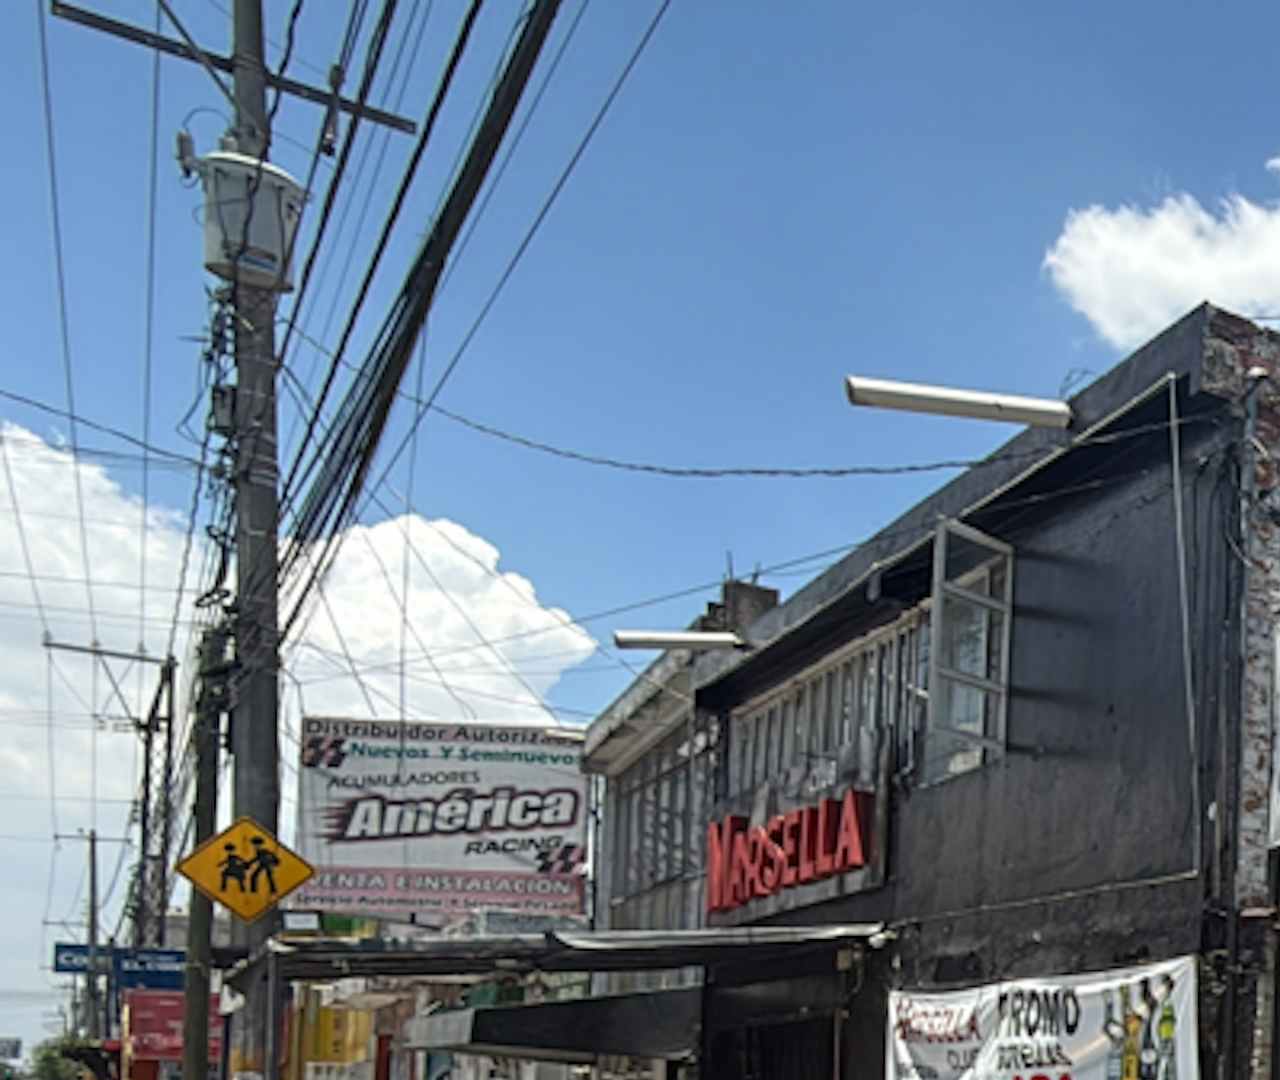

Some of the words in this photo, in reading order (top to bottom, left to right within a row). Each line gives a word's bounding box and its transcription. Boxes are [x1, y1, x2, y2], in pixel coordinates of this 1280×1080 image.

[350, 742, 431, 759] Nuevos
[328, 771, 480, 790] ACUMULADORES
[340, 784, 580, 842] América
[464, 836, 565, 856] RACING
[708, 788, 868, 912] MARSELLA
[312, 872, 385, 890] VENTA
